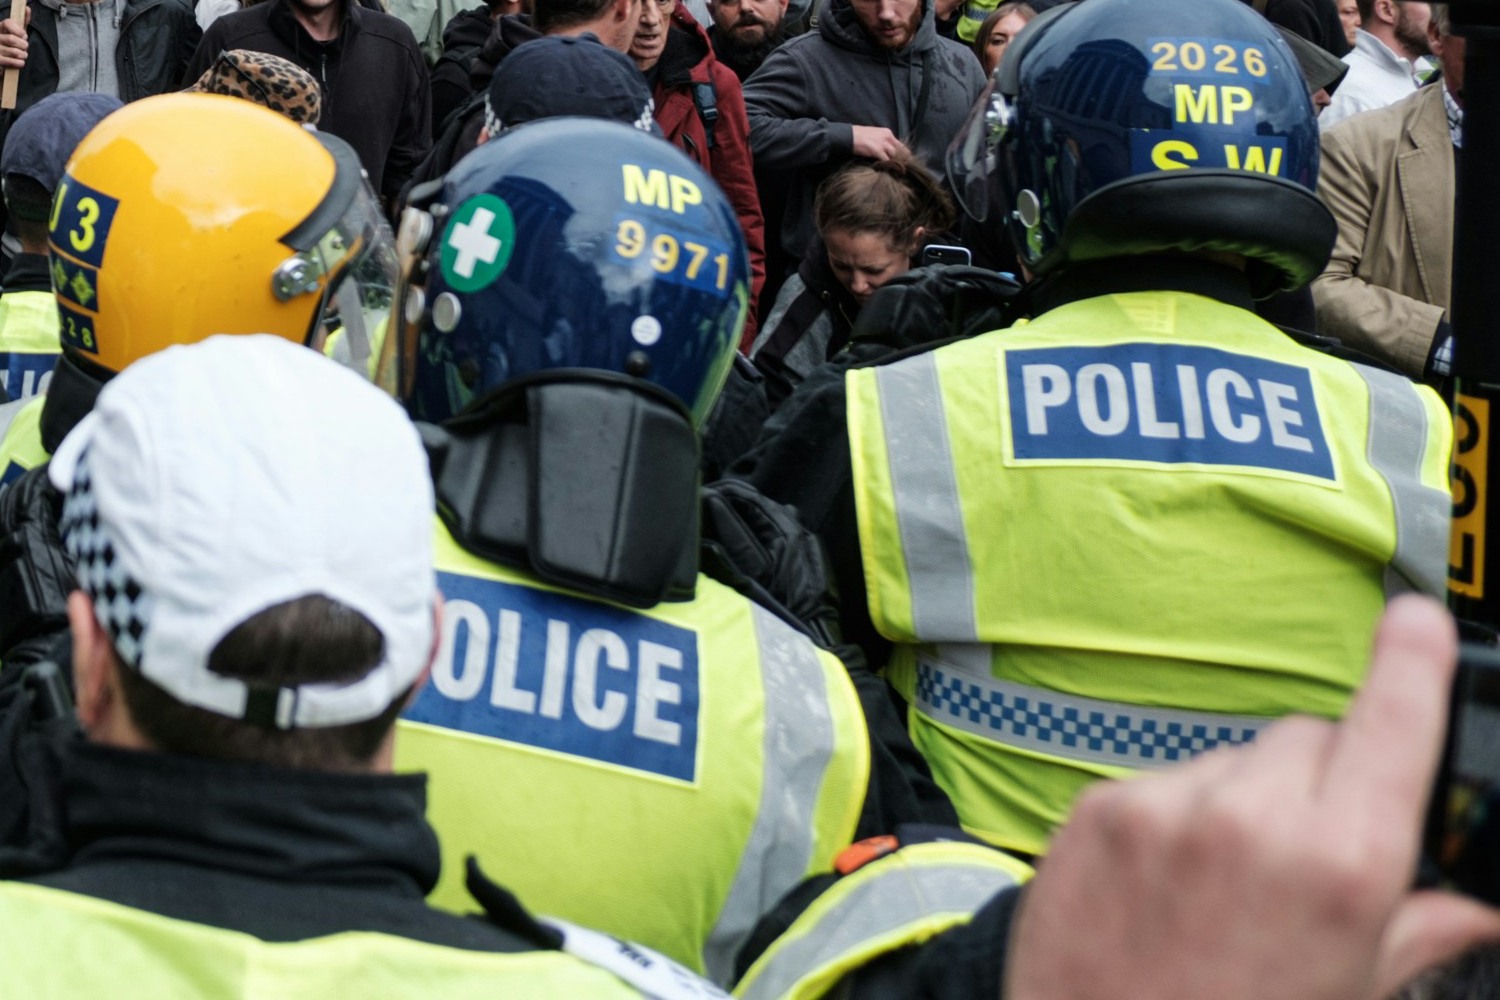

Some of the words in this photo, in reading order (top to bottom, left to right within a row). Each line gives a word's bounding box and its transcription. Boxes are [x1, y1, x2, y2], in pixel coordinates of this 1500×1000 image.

[1150, 41, 1268, 78] 2026
[1173, 83, 1254, 126] MP
[621, 163, 703, 215] MP
[615, 219, 730, 290] 9971
[1021, 361, 1315, 454] POLICE
[431, 598, 684, 746] OLICE
